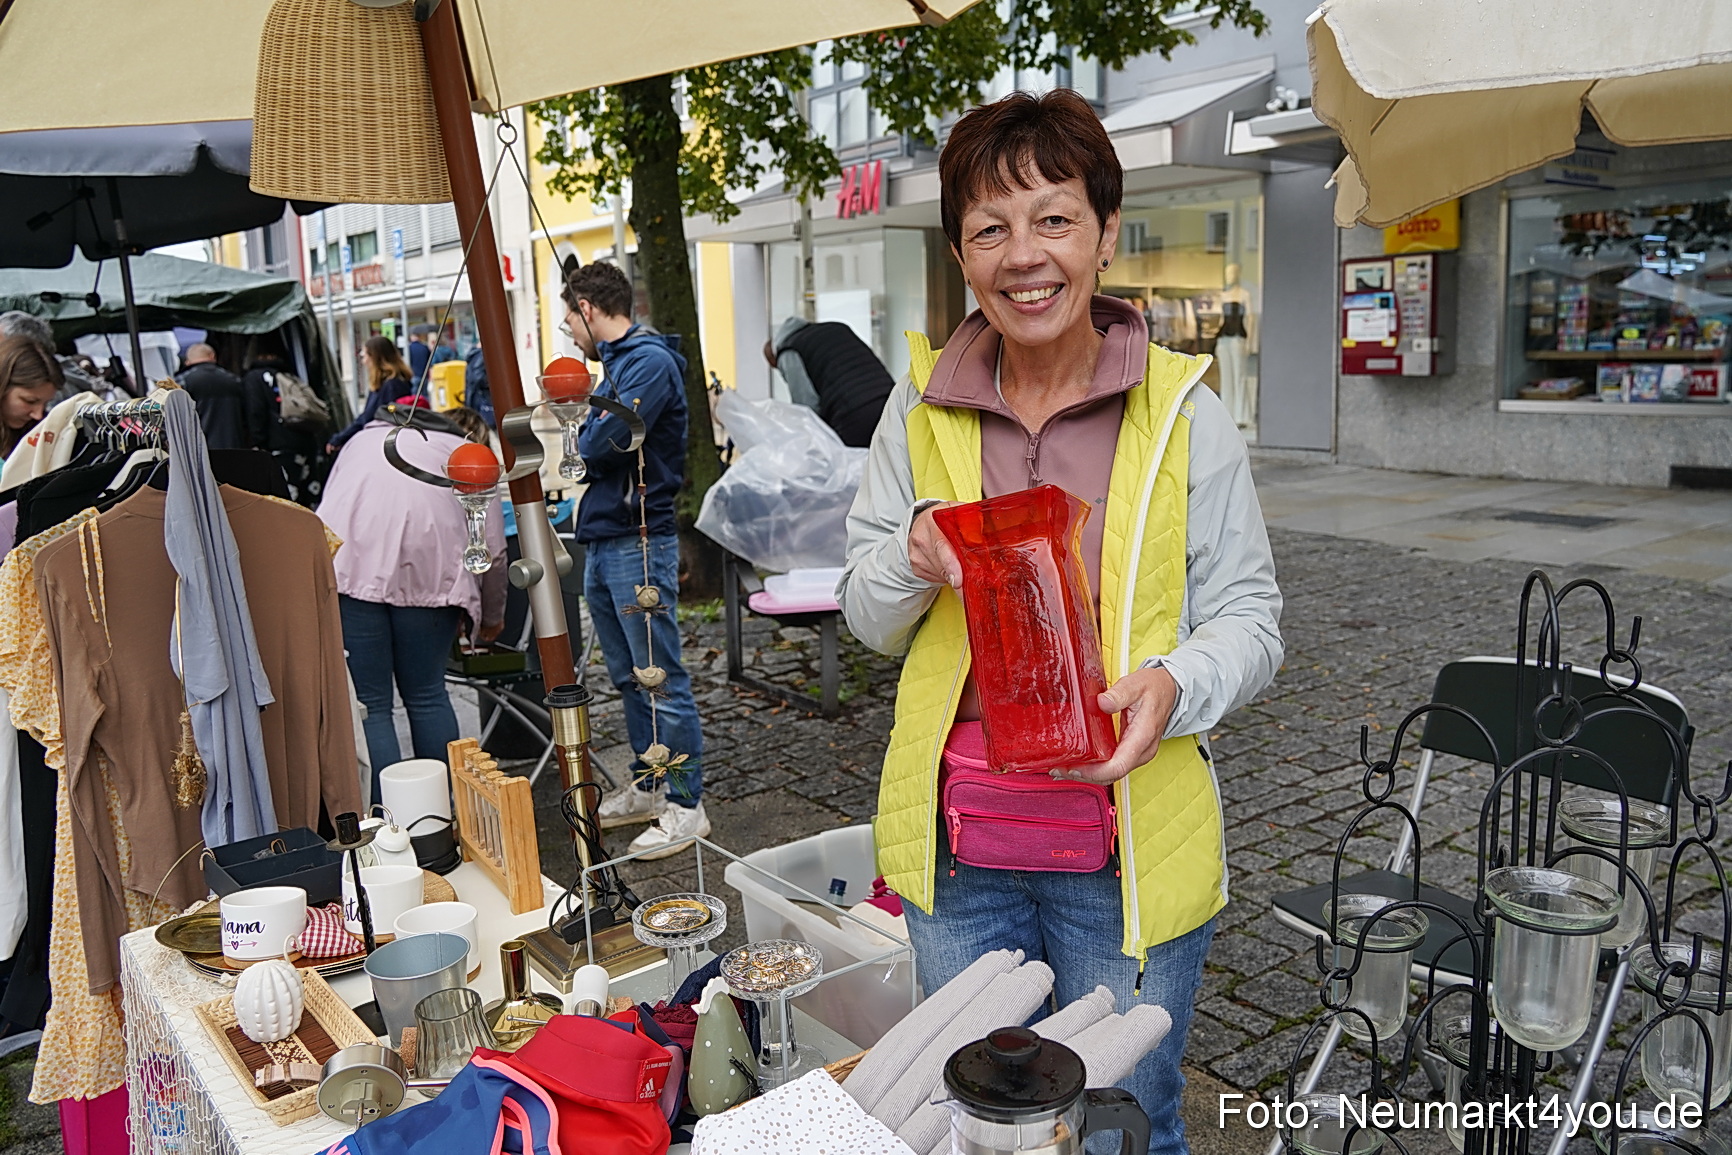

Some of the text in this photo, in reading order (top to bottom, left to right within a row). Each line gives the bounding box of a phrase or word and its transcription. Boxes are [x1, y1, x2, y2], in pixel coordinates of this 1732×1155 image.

[836, 159, 882, 219] H&M
[1397, 218, 1441, 236] LOTTO
[1051, 849, 1086, 858] CMP
